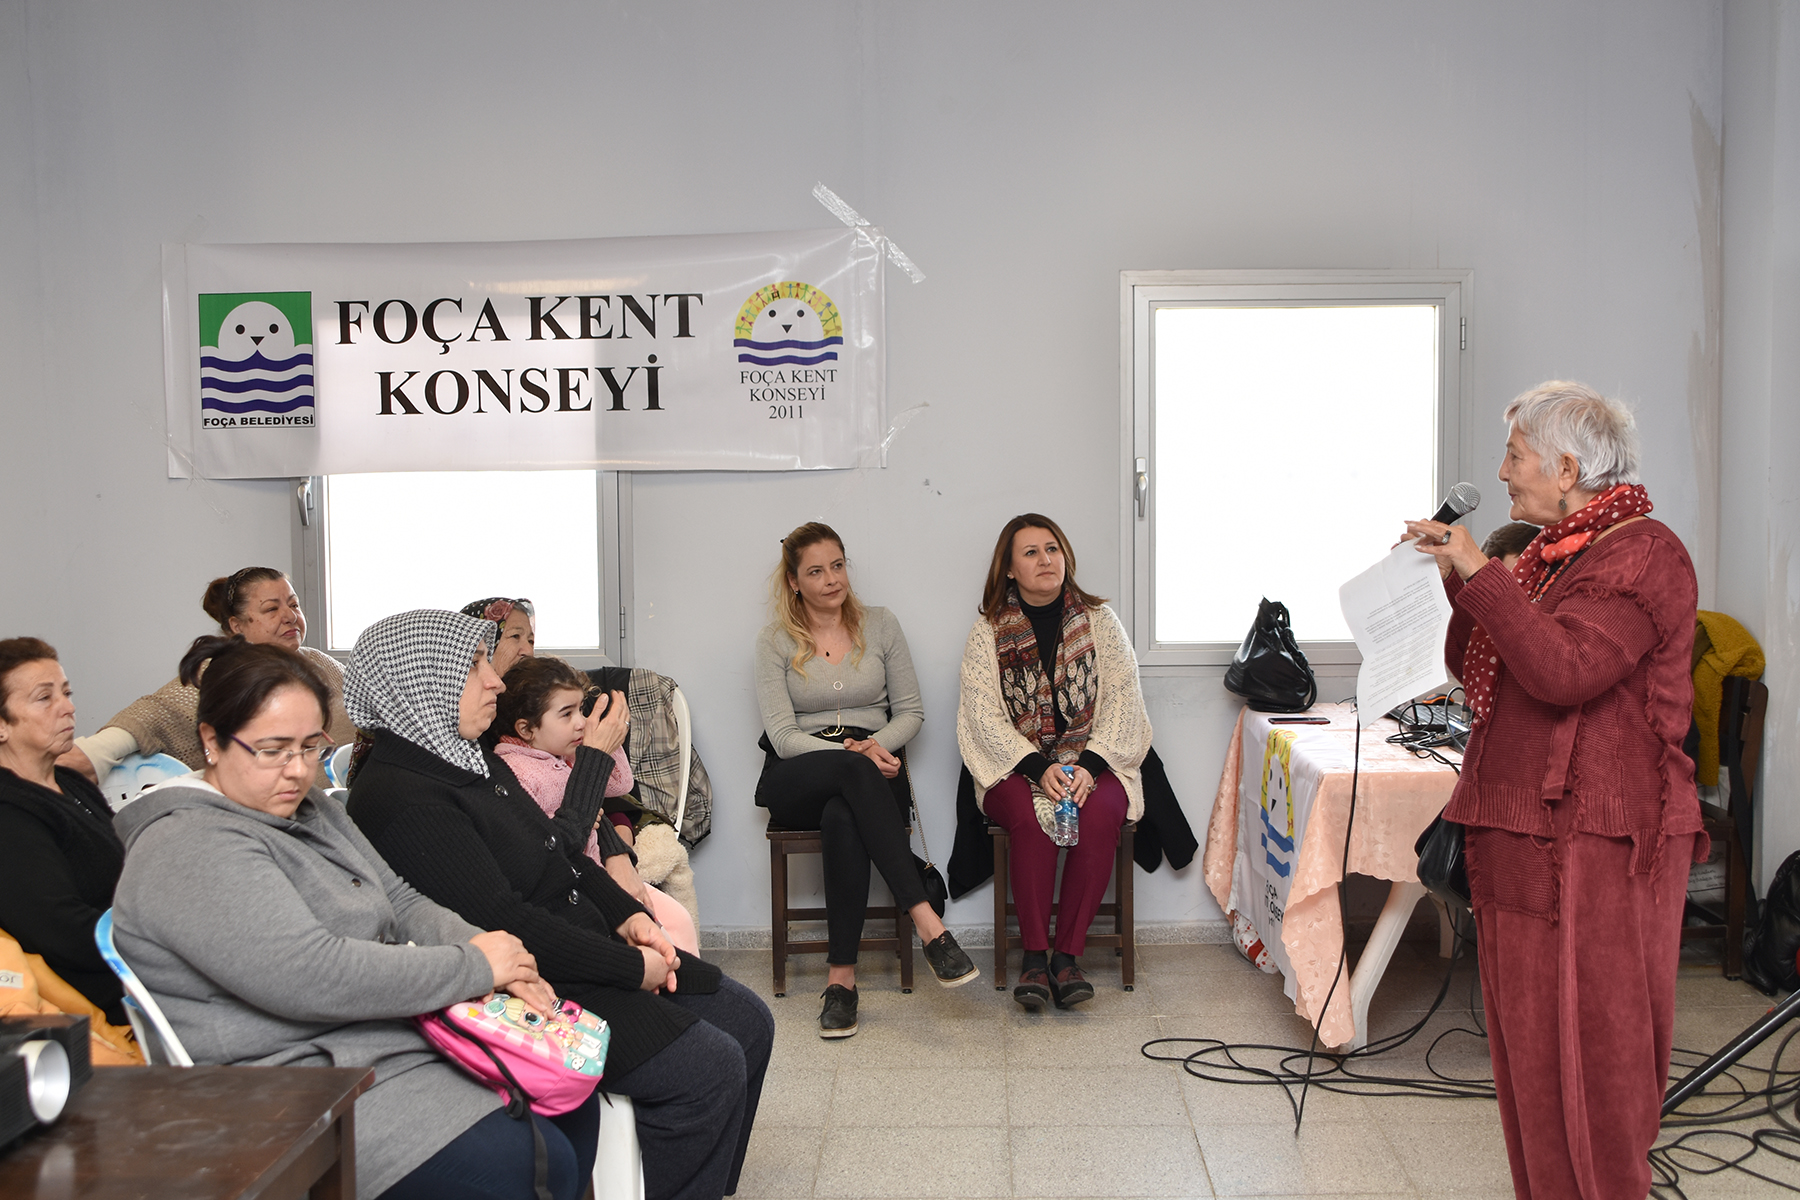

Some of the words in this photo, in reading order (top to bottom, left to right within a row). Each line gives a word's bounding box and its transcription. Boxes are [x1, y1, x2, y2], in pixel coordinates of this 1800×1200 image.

[334, 297, 511, 355] FOÇA
[524, 293, 703, 341] KENT
[374, 353, 665, 415] KONSEYİ
[740, 370, 786, 386] FOÇA
[791, 369, 838, 383] KENT
[749, 384, 826, 402] KONSEYİ
[769, 405, 803, 420] 2011
[203, 417, 237, 429] FOÇA
[240, 414, 314, 426] BELEDİYESİ
